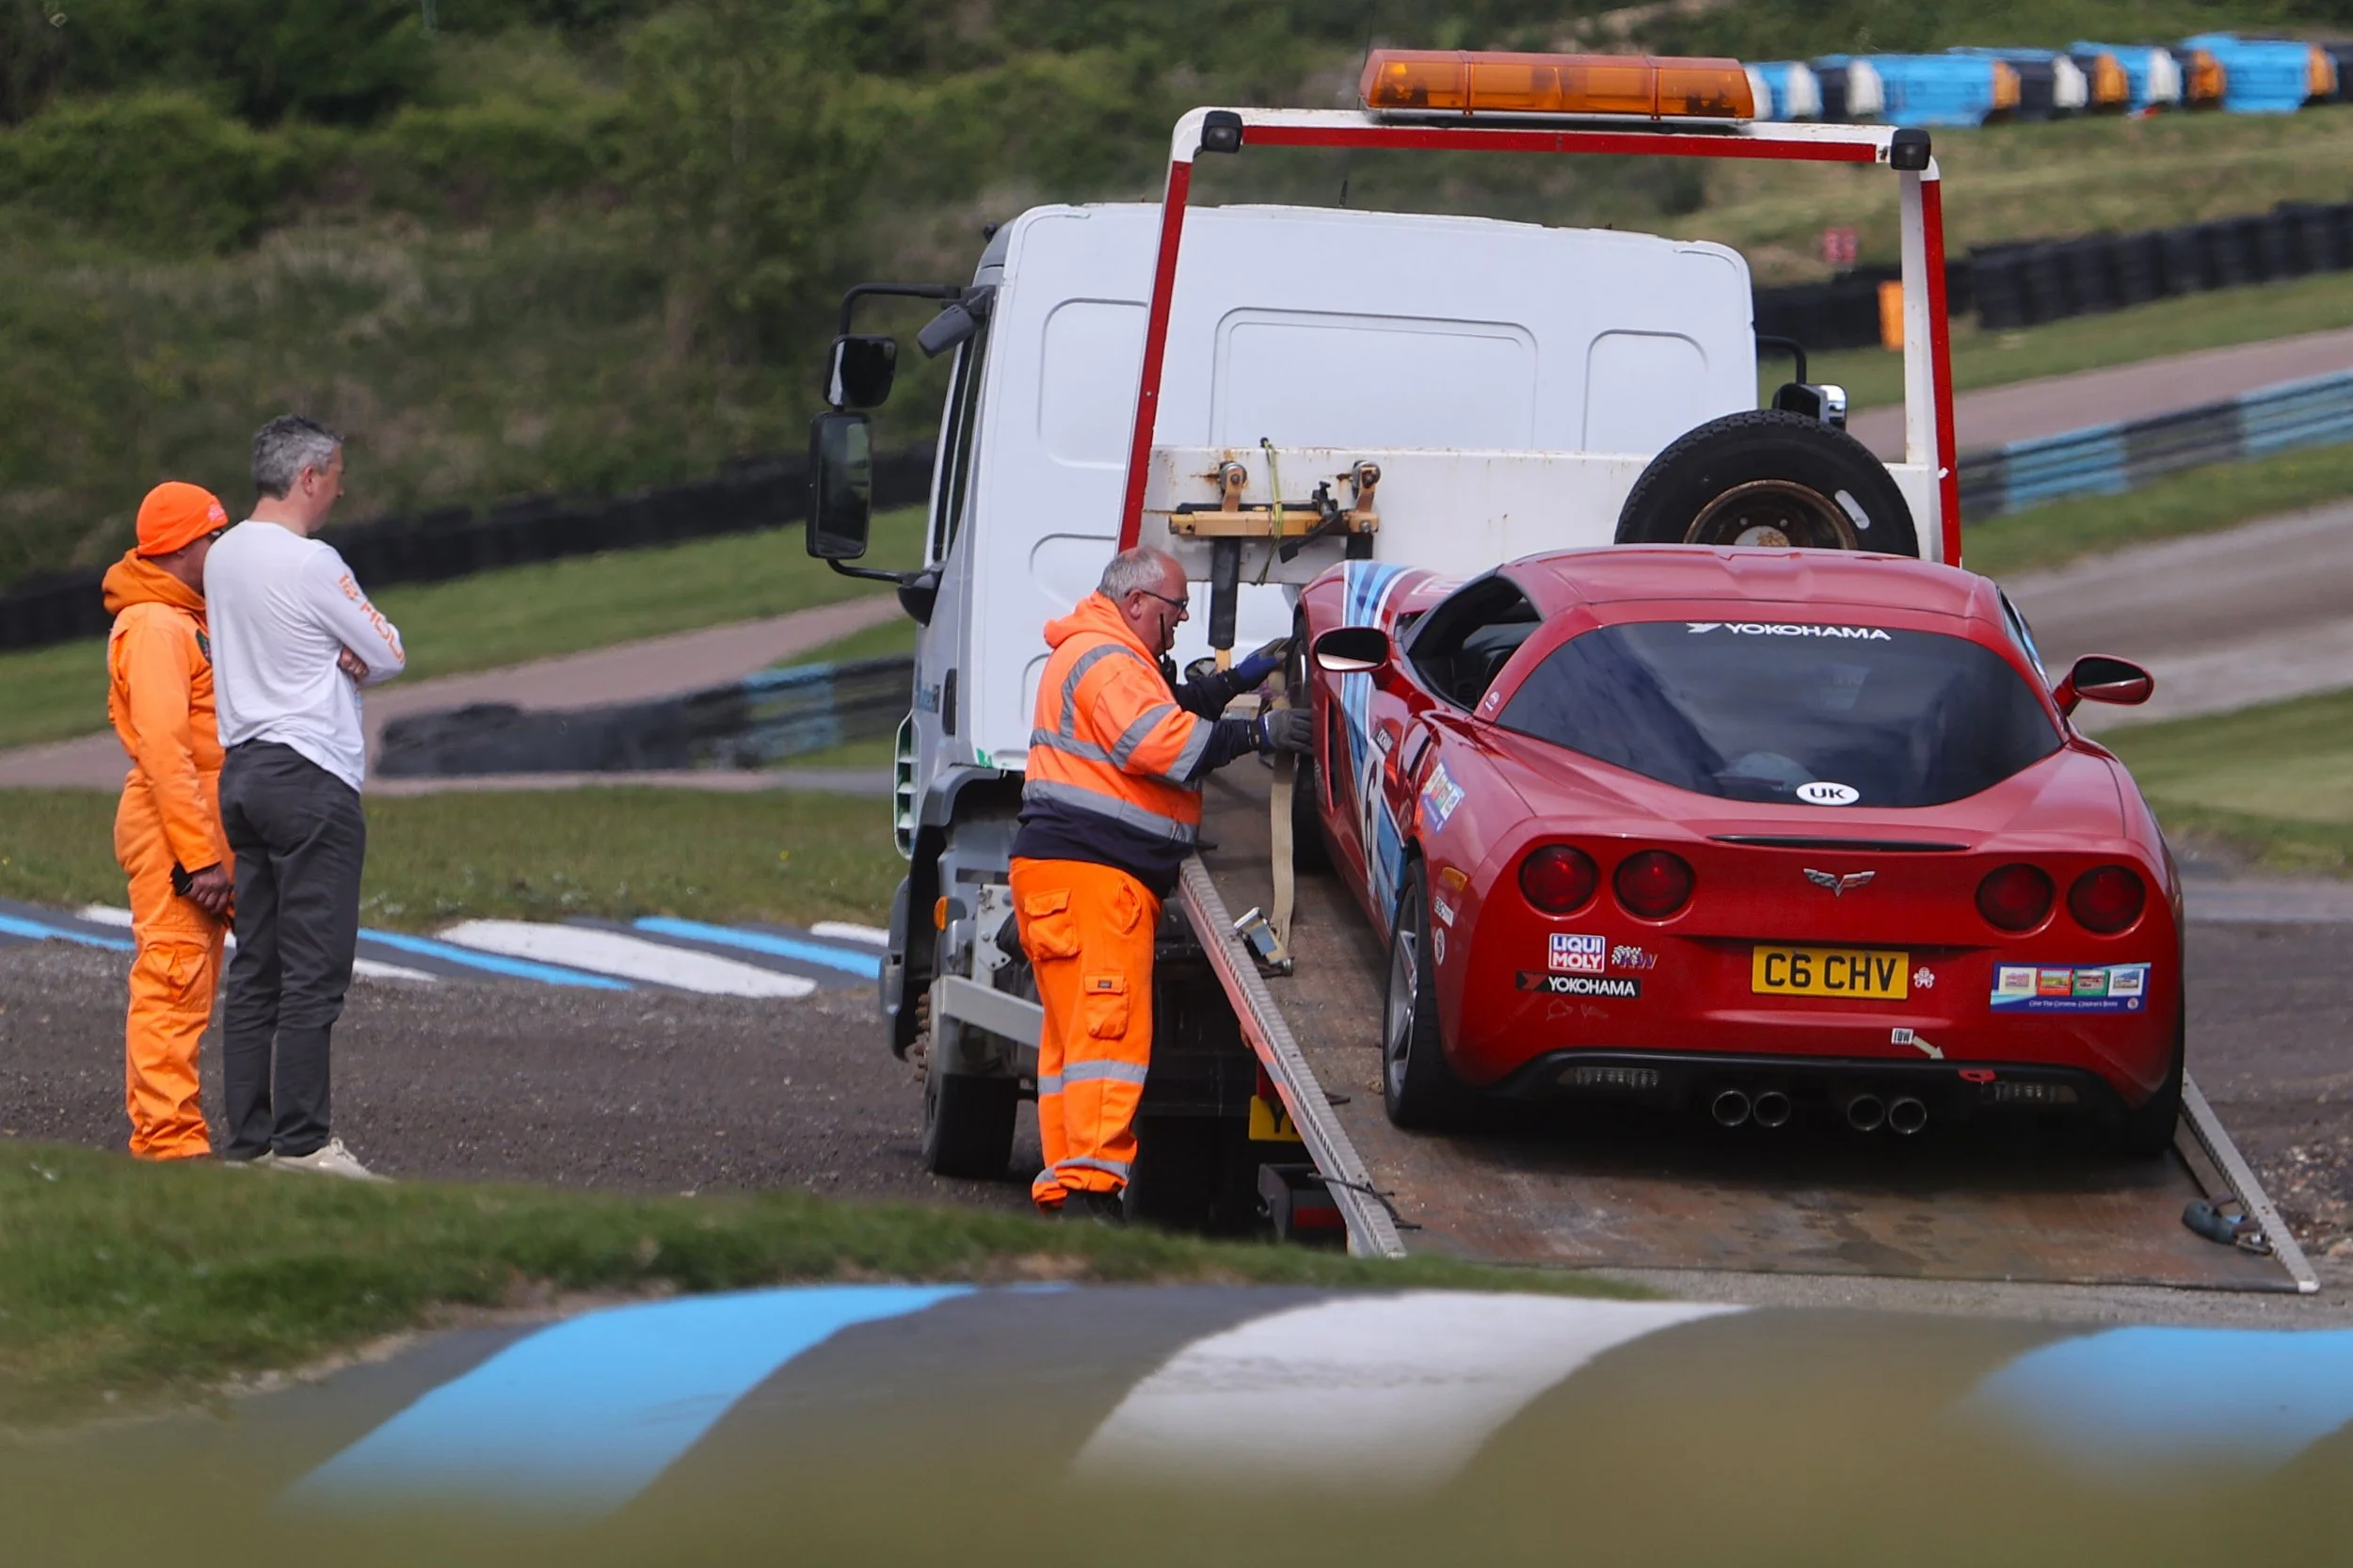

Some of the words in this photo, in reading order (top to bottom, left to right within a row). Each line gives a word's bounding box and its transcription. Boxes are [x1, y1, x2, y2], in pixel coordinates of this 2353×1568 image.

[1723, 622, 1892, 641] YOKOHAMA
[1809, 787, 1847, 800] UK
[1365, 760, 1378, 873] 6
[1553, 936, 1602, 954] LIQUI
[1552, 952, 1602, 969] MOLY
[1765, 952, 1813, 988] C6
[1824, 955, 1897, 992] CHV
[1547, 976, 1637, 998] YOKOHAMA
